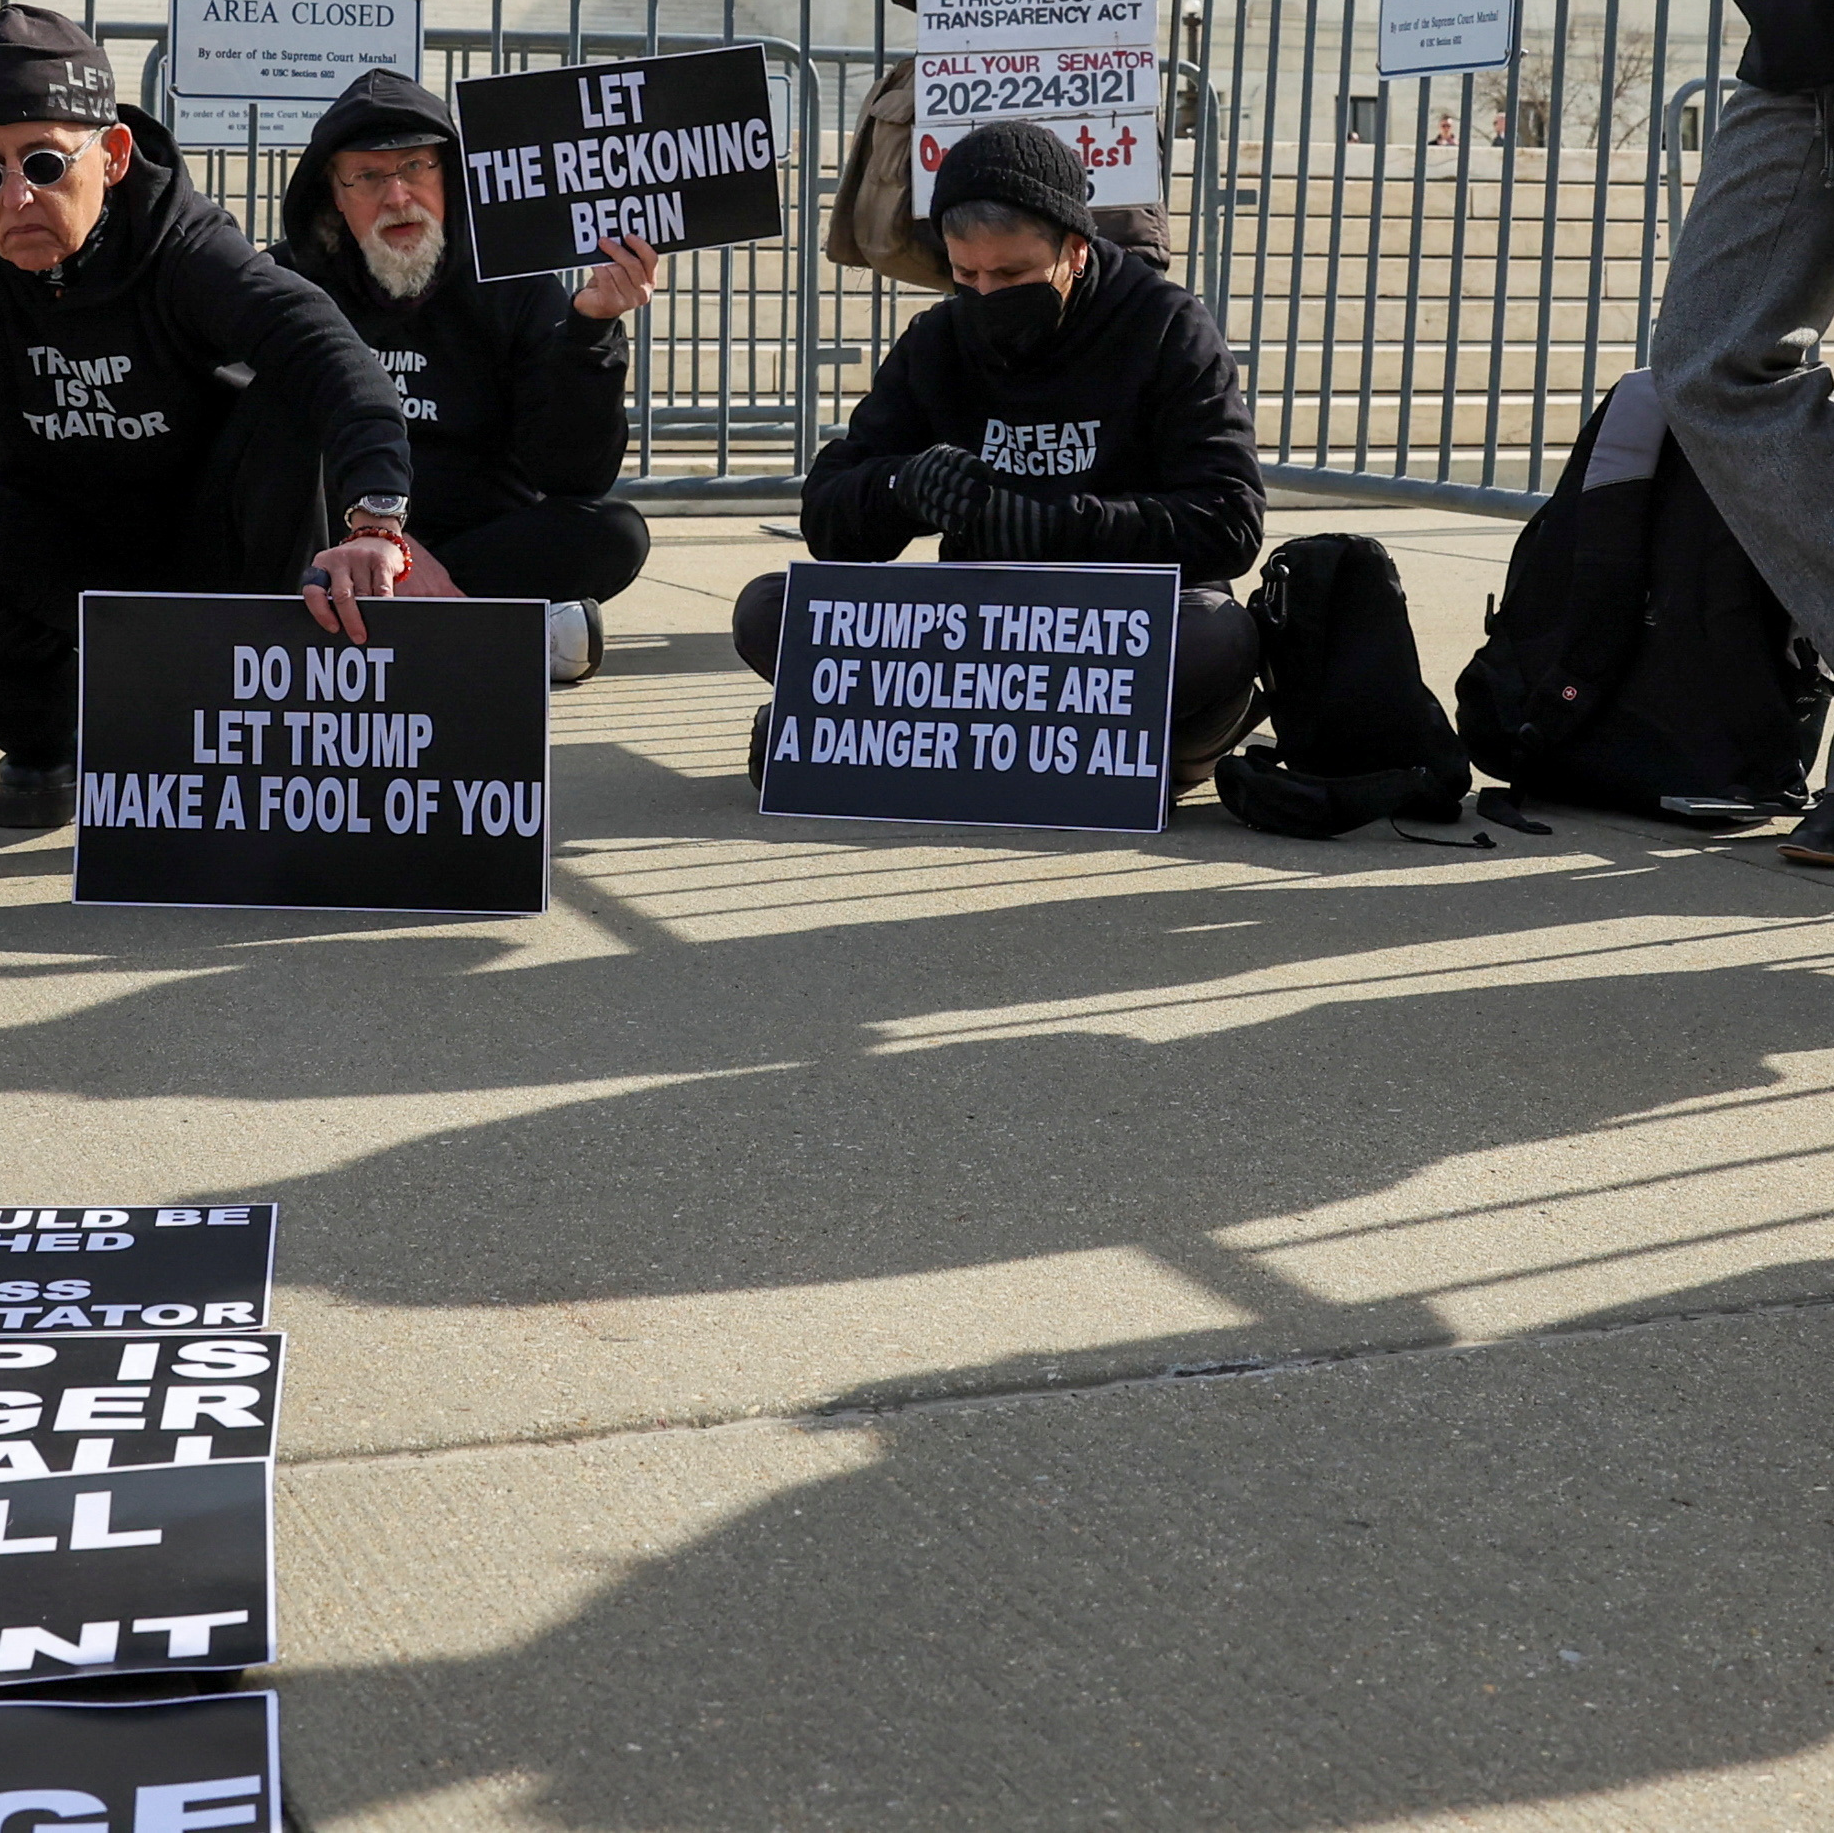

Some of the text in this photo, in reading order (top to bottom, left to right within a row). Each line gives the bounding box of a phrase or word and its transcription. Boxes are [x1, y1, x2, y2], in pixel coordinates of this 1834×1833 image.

[203, 0, 394, 27] AREA CLOSED
[923, 3, 1142, 30] TRANSPARENCY ACT
[198, 48, 397, 64] By order of the Supreme Court Marshal
[922, 51, 1154, 78] CALL YOUR SENATOR
[578, 71, 646, 130] LET
[926, 70, 1135, 116] 202-224-3121
[468, 118, 770, 204] THE RECKONING
[571, 191, 685, 254] BEGIN
[55, 379, 117, 413] IS A
[23, 410, 170, 441] TRAITOR
[984, 419, 1101, 451] DEFEAT
[980, 444, 1097, 476] FASCISM
[808, 599, 1150, 658] TRUMP’S THREATS
[233, 645, 395, 703] DO NOT
[811, 657, 1134, 716] OF VIOLENCE ARE
[193, 709, 433, 769] LET TRUMP
[773, 715, 1158, 778] A DANGER TO US ALL
[82, 771, 542, 838] MAKE A FOOL OF YOU
[154, 1208, 252, 1228] BE
[113, 1339, 272, 1381] IS
